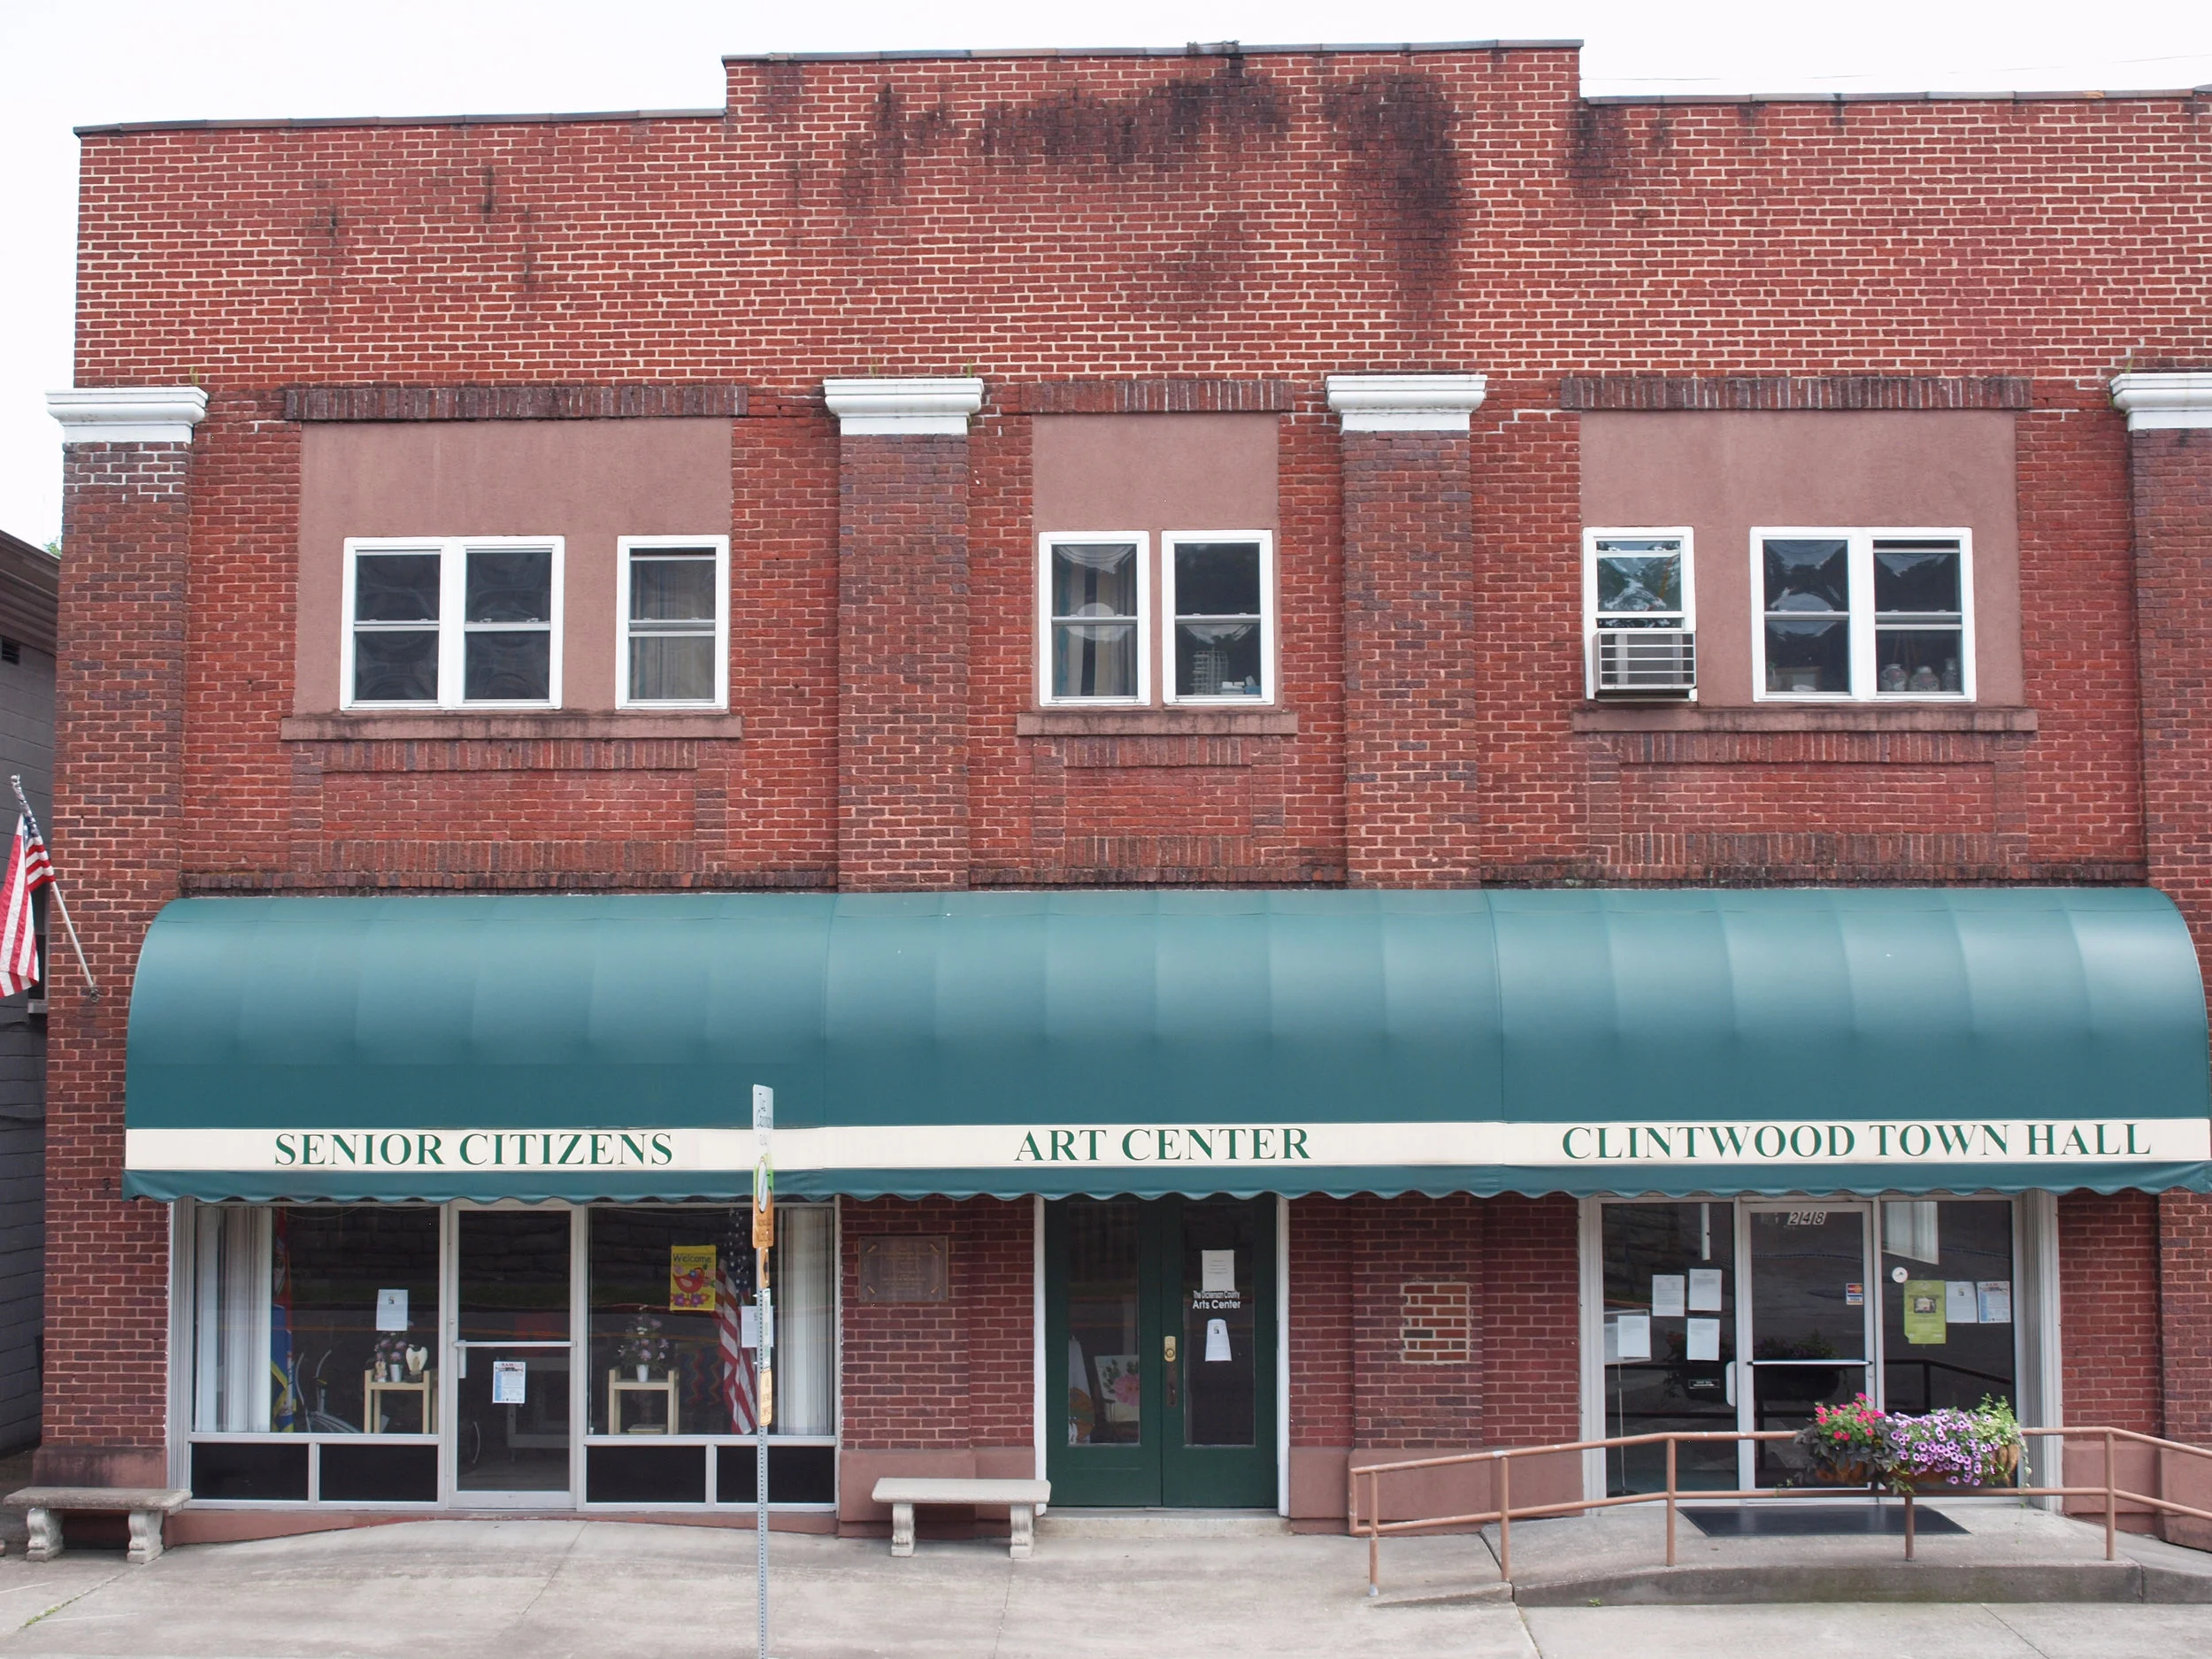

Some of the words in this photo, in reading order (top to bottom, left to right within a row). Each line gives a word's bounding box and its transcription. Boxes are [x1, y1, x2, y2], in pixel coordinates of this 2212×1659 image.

[275, 1133, 446, 1166] SENIOR
[458, 1133, 673, 1166] CITIZENS
[1015, 1128, 1108, 1162] ART
[1122, 1127, 1311, 1161] CENTER
[1563, 1125, 1855, 1160] CLINTWOOD
[1868, 1124, 2008, 1157] TOWN
[2026, 1123, 2153, 1156] HALL
[1789, 1211, 1824, 1225] 248
[672, 1253, 712, 1263] Welcome
[1192, 1299, 1210, 1310] Arts
[1211, 1299, 1241, 1310] Center
